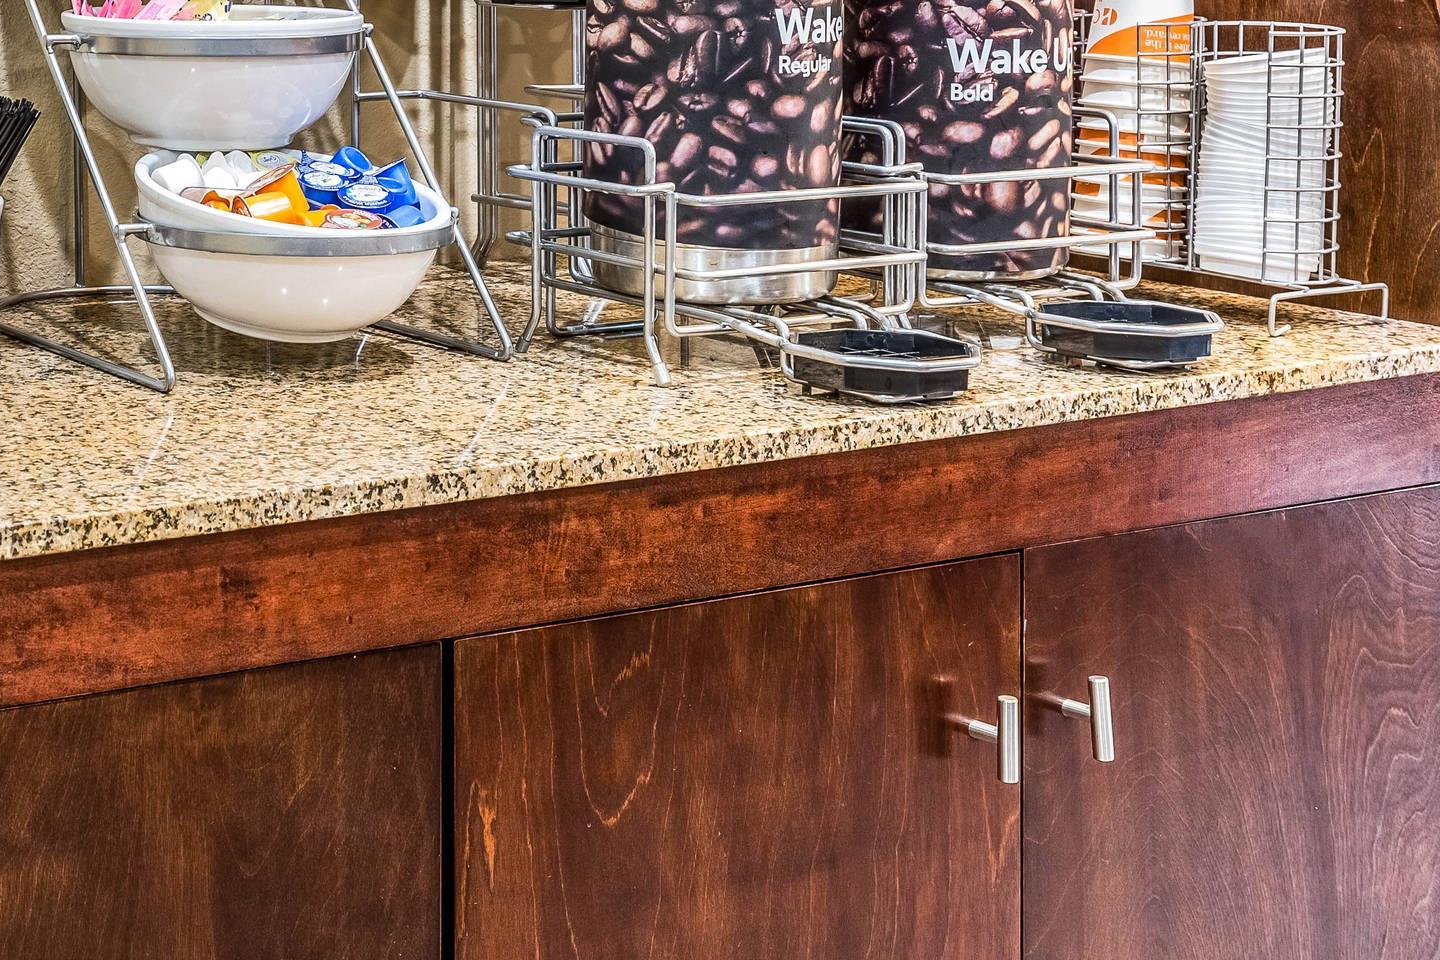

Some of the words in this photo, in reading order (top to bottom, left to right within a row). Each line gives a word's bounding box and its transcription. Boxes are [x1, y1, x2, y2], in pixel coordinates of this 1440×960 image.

[775, 6, 842, 44] Wake
[778, 54, 832, 77] Regular
[946, 38, 1048, 74] Wake
[950, 83, 994, 101] Bold
